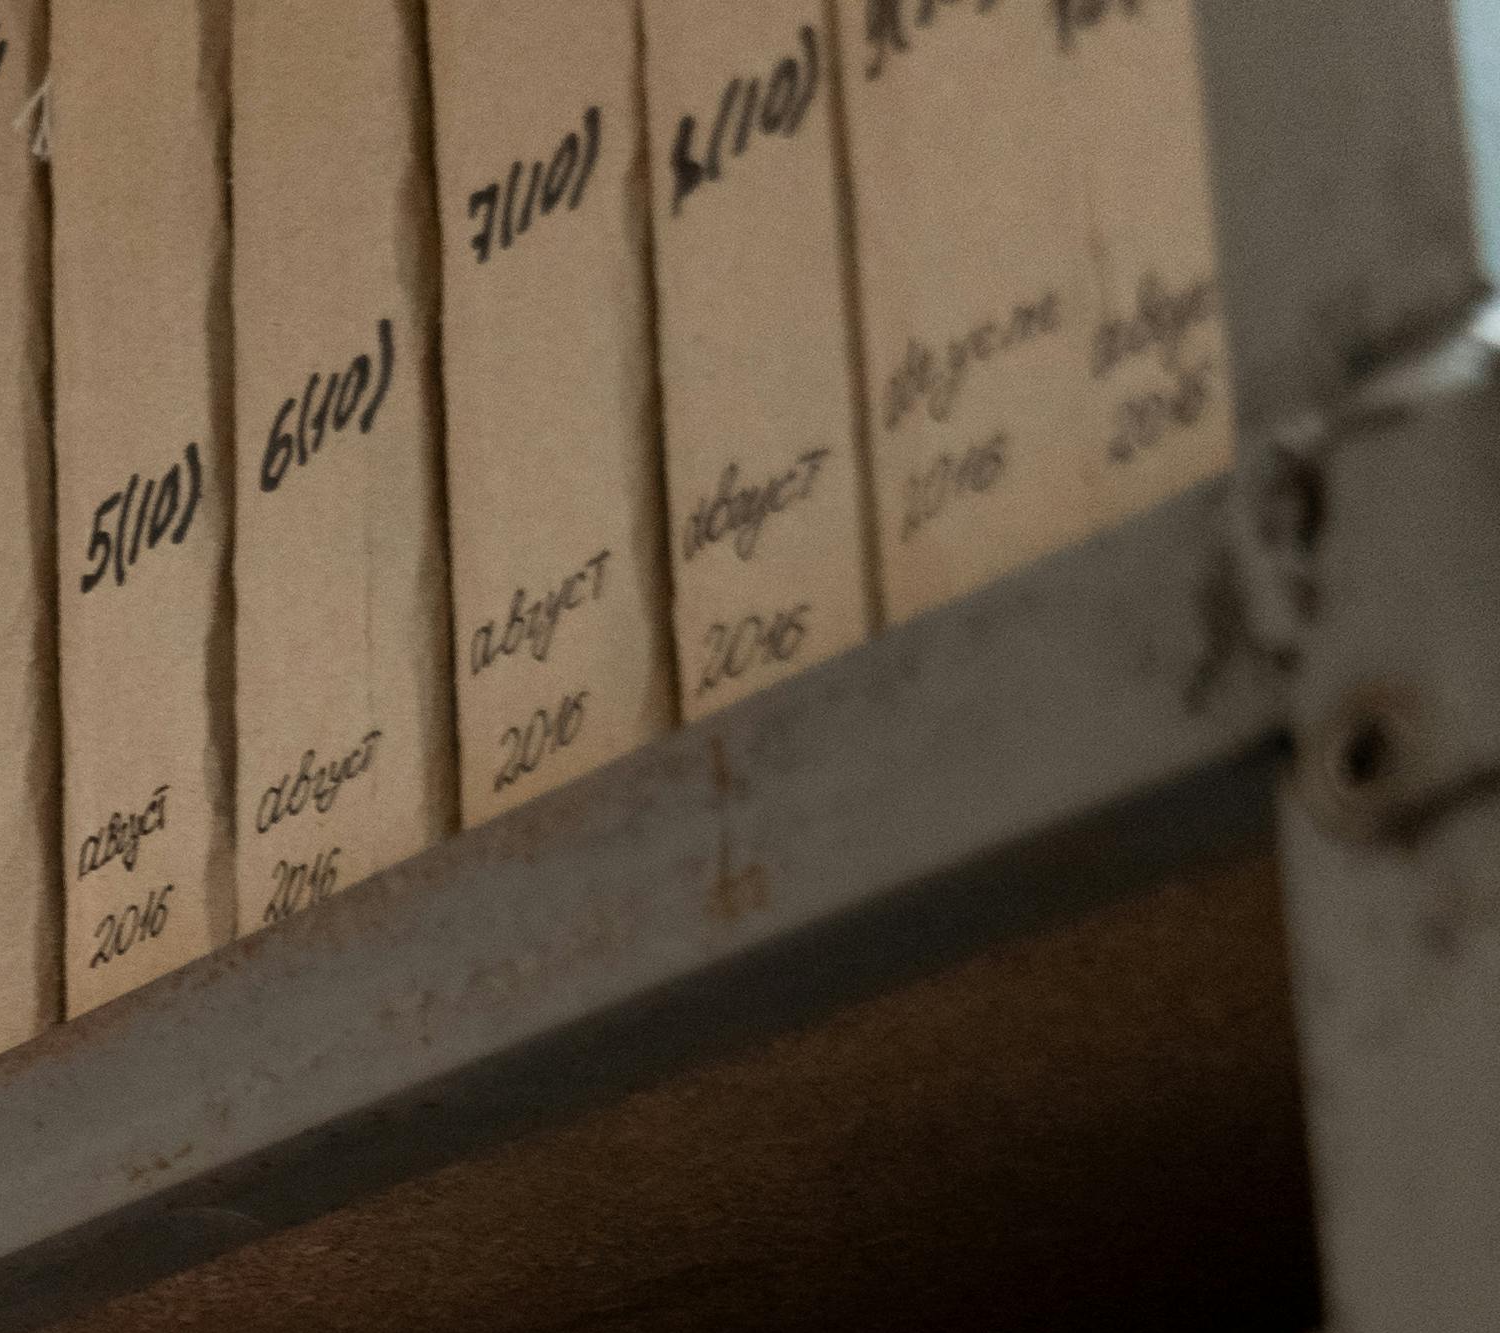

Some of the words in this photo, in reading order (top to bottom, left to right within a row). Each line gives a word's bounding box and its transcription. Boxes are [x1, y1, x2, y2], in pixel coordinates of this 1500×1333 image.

[467, 106, 602, 264] 7(10)
[260, 318, 395, 493] 6(10)
[80, 443, 202, 593] 5(10)
[90, 884, 174, 968] 2016
